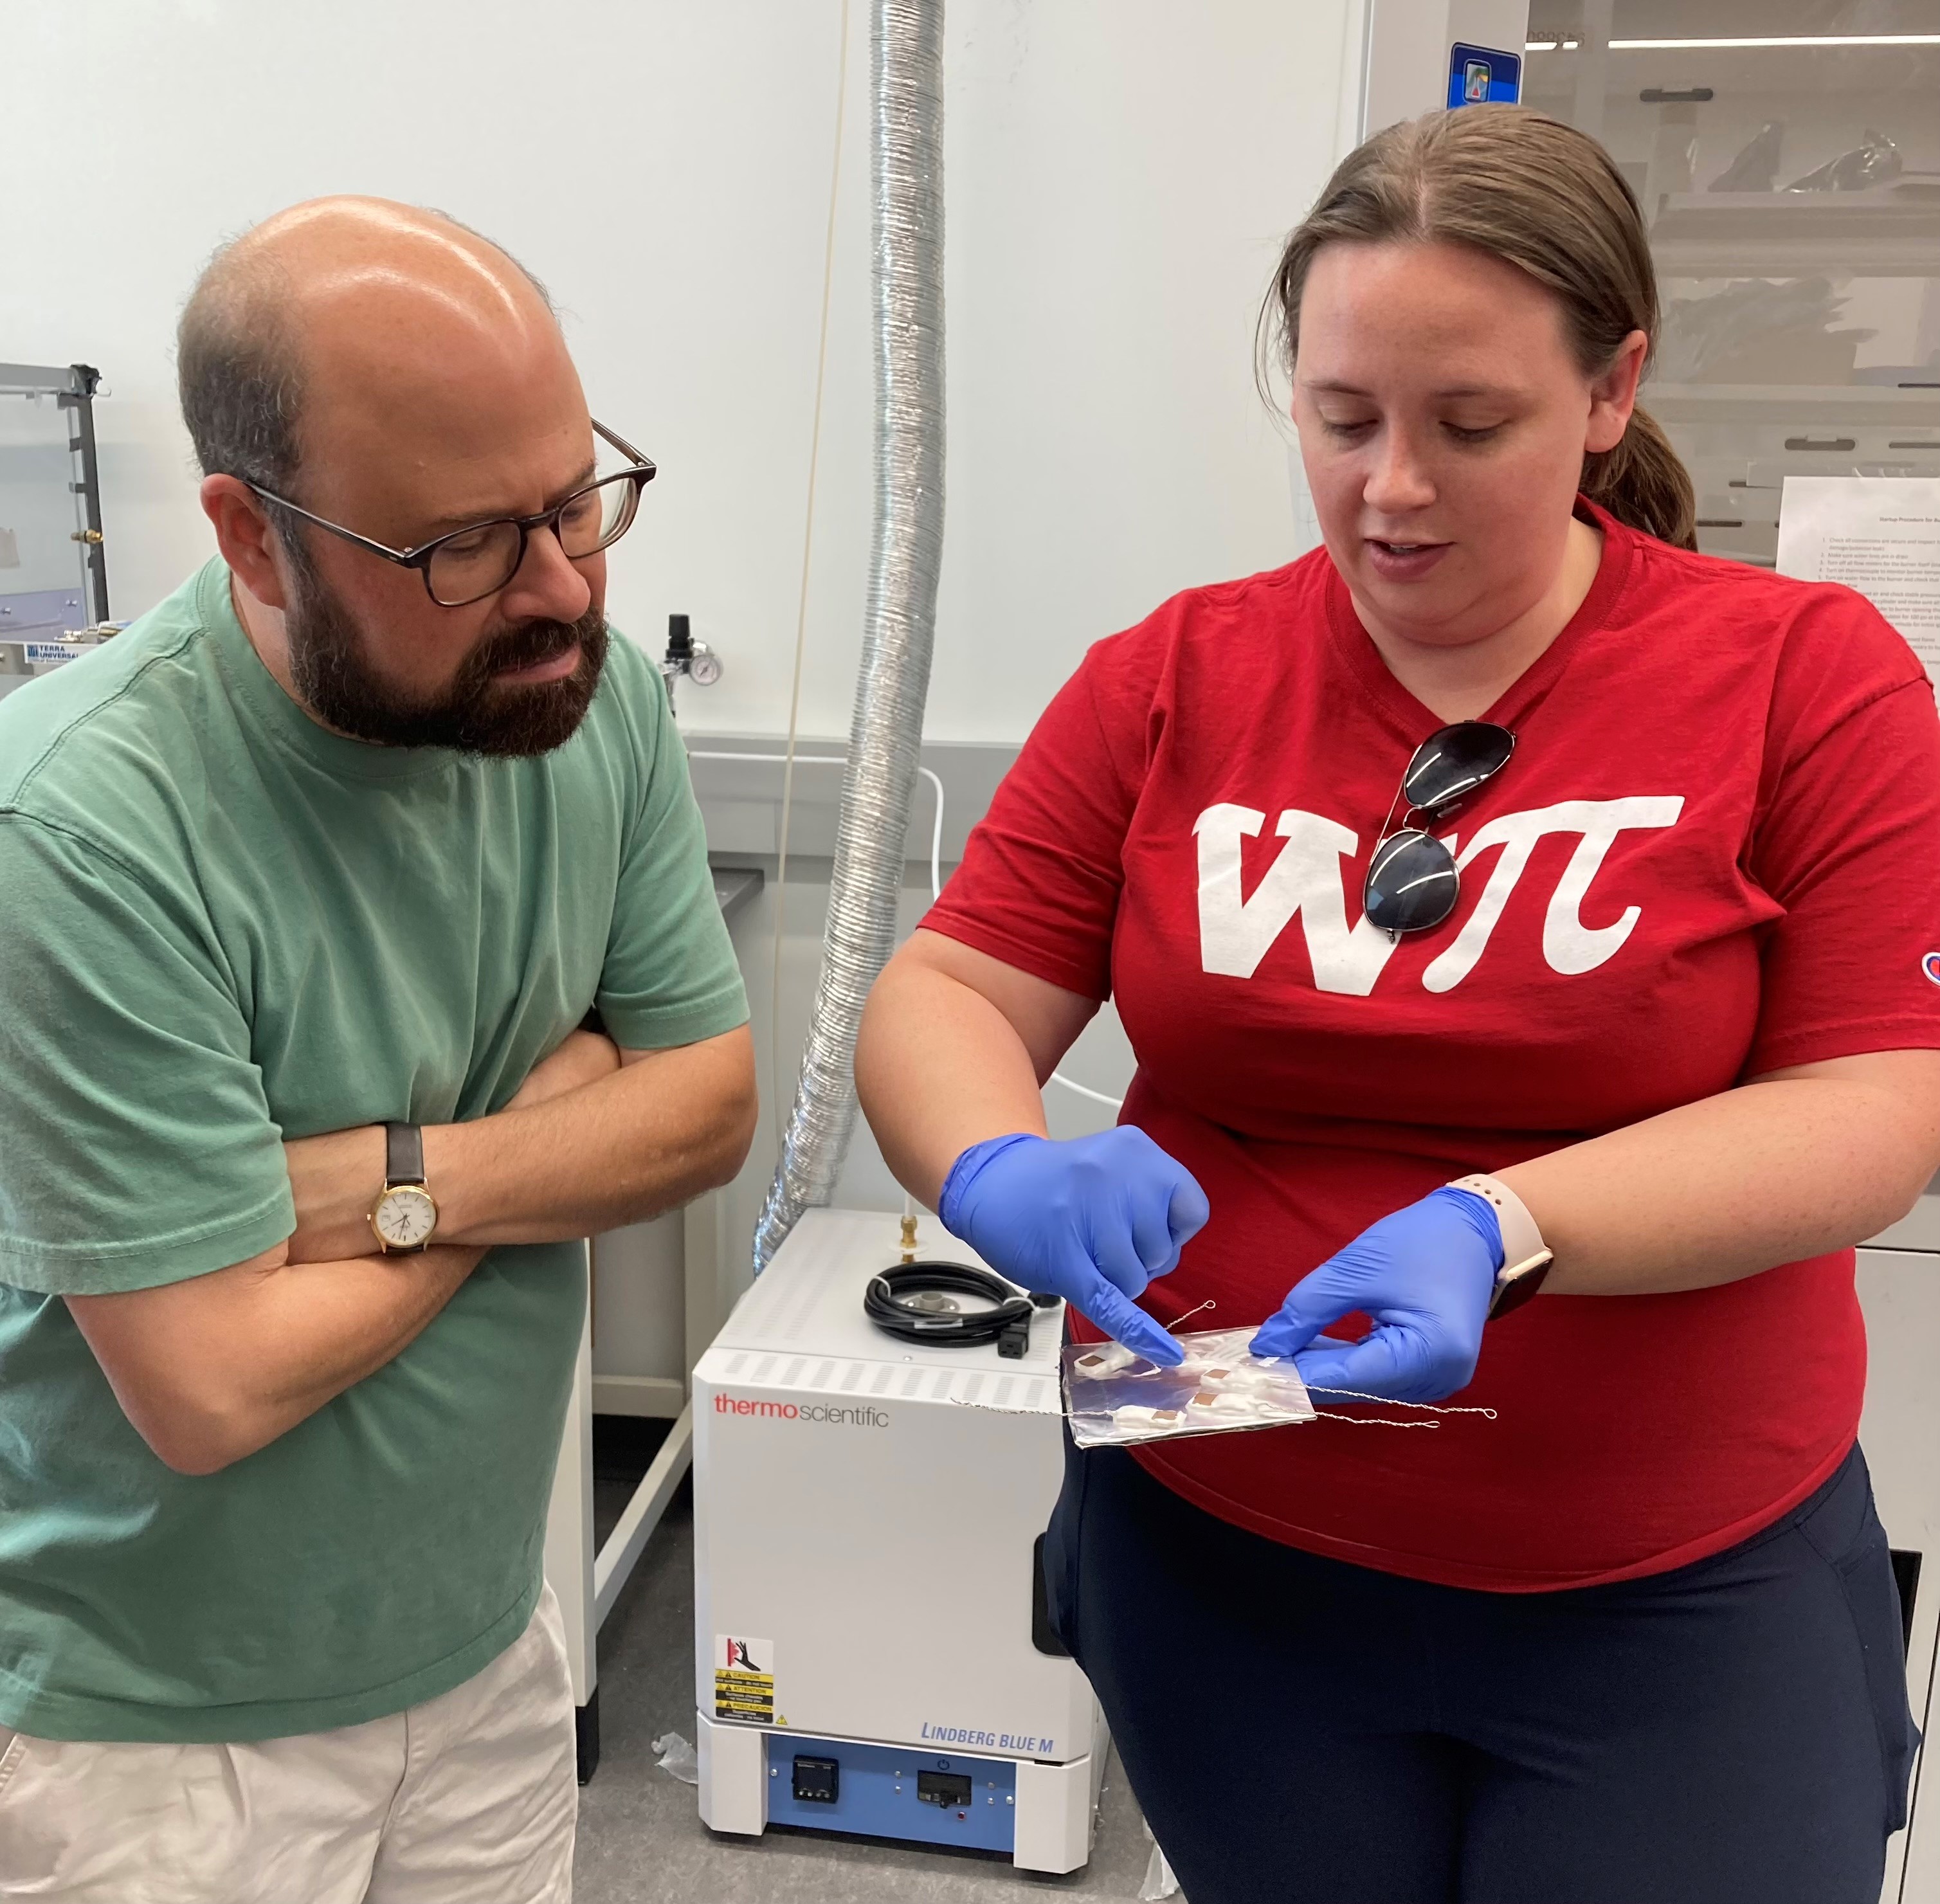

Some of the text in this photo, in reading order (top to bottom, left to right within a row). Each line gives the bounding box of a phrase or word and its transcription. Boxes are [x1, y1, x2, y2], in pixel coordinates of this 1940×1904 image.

[733, 1686, 767, 1694] ATTENTION
[921, 1722, 1054, 1753] LINDBERG BLUE M
